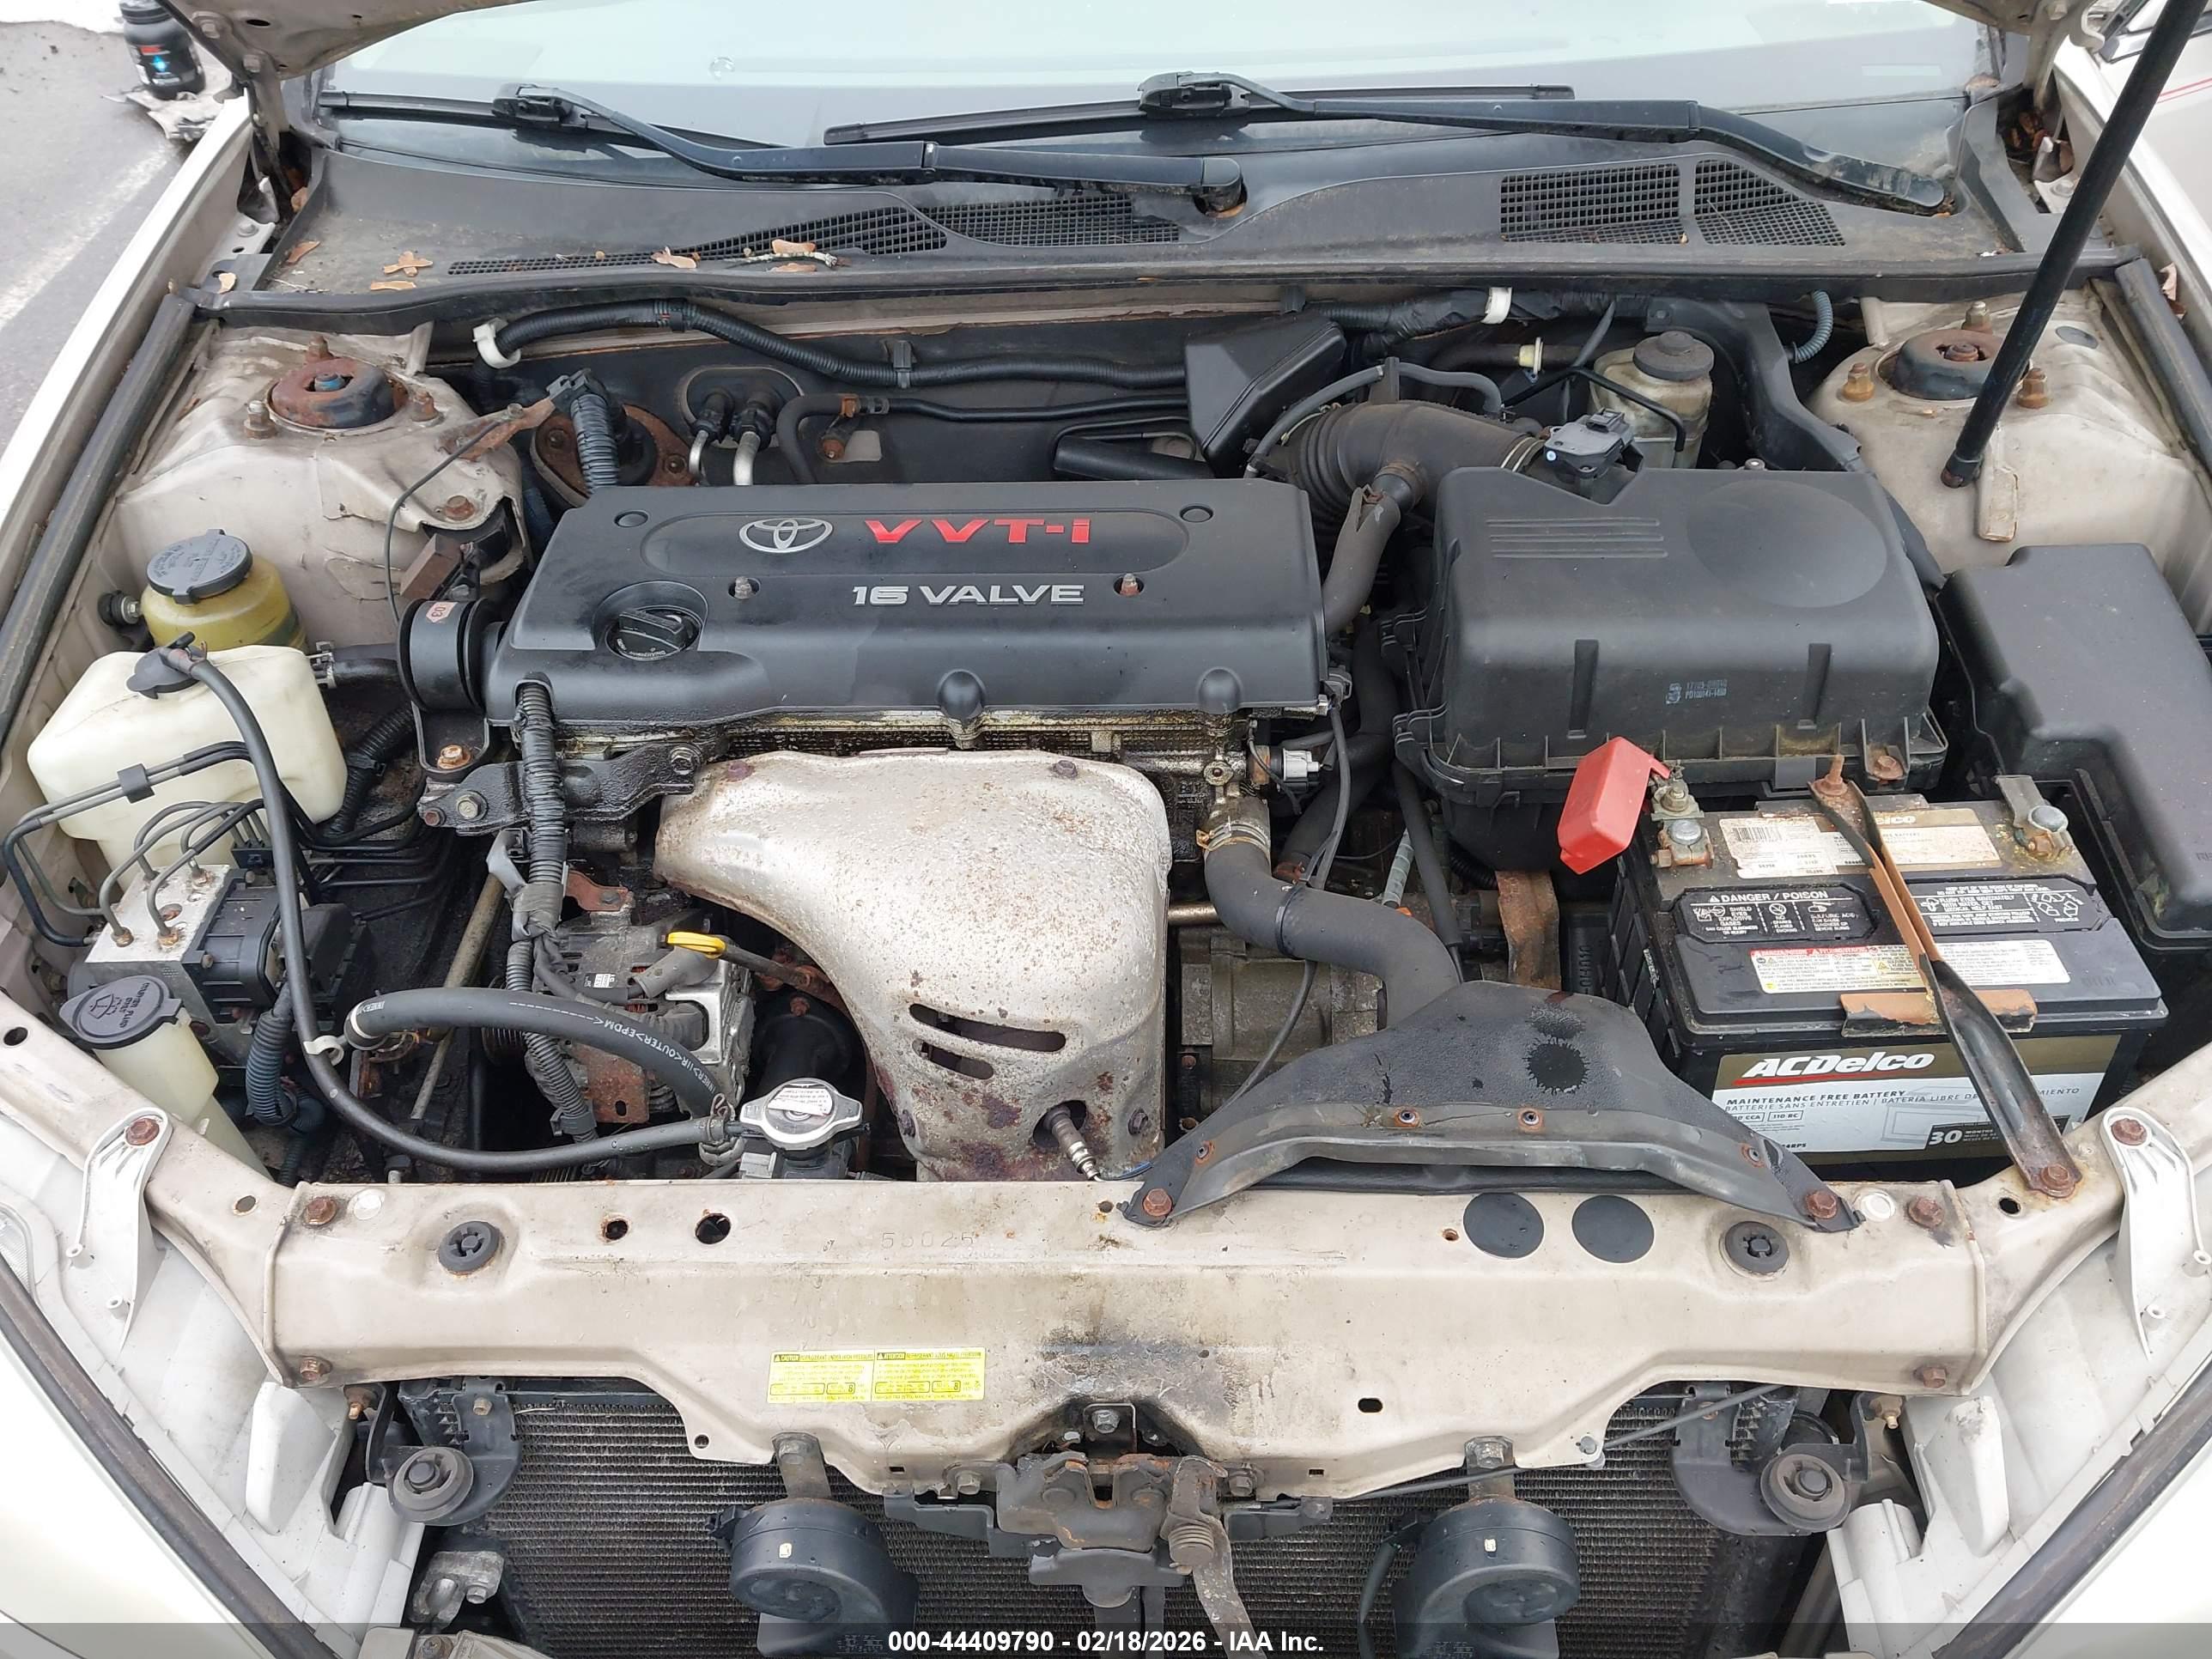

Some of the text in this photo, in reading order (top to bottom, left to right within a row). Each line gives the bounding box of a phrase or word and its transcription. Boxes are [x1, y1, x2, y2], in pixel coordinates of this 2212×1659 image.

[864, 519, 1091, 544] VVT-i
[853, 584, 1085, 606] 16 VALVE
[1722, 893, 1770, 902] DANGER
[1783, 890, 1828, 899] POISON
[1741, 1052, 1935, 1078] ACDelco
[1725, 1103, 1772, 1112] BATTERIE
[1778, 1101, 1805, 1109] SANS
[1809, 1098, 1869, 1108] ENTRETIEN
[1727, 1095, 1816, 1106] MAINTENANCE
[1853, 1091, 1905, 1099] BATTERY
[1929, 1129, 1963, 1146] 30
